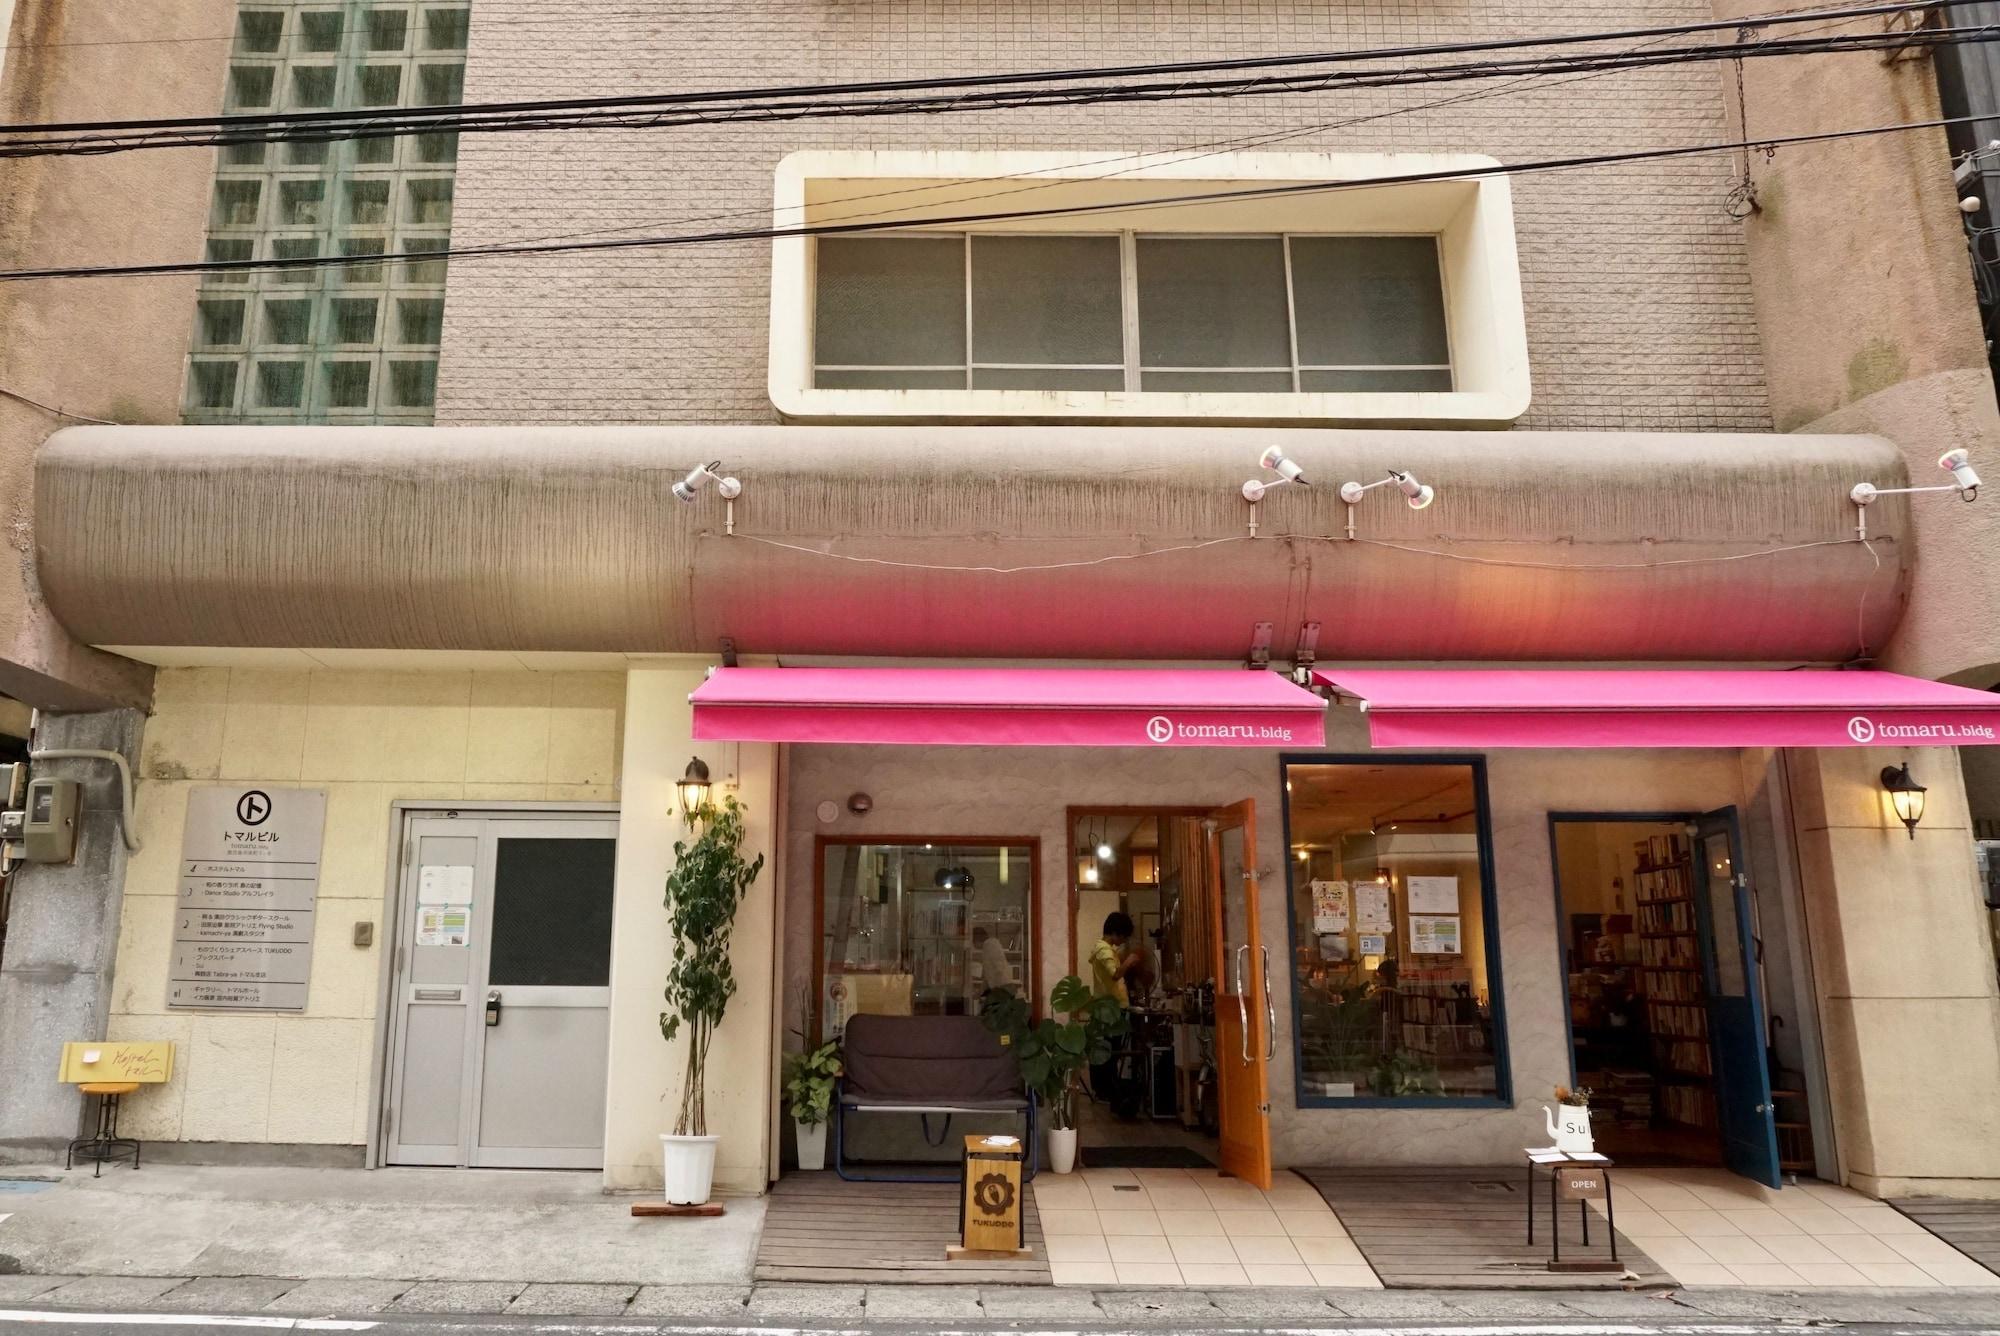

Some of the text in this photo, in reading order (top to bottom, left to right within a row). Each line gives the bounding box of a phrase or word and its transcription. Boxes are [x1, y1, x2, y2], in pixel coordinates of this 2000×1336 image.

[1178, 722, 1292, 741] tomaru.bldg
[1878, 722, 1995, 739] tomaru.bldg
[224, 831, 280, 842] トマルビル
[1571, 1180, 1597, 1189] OPEN
